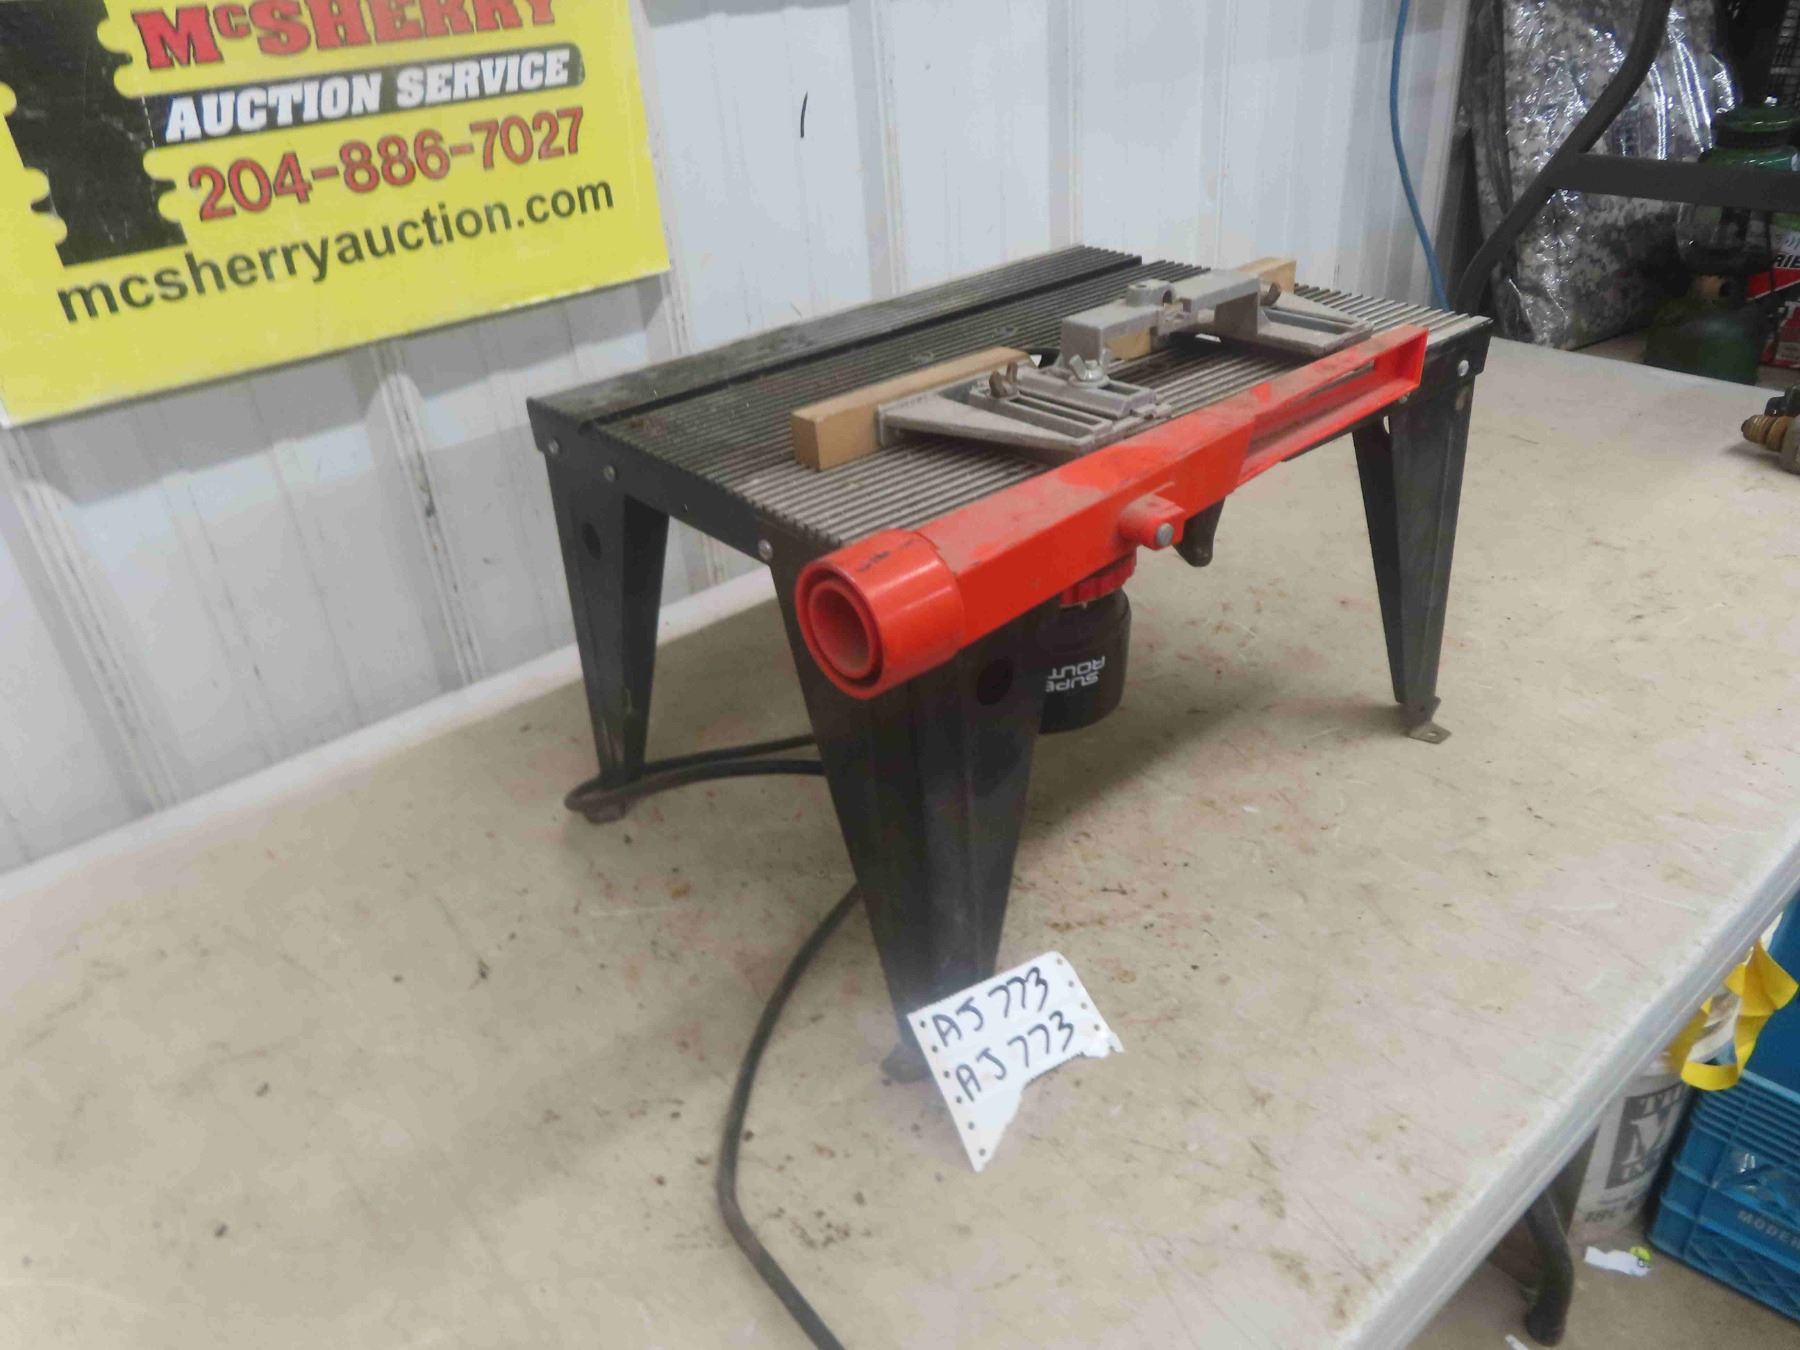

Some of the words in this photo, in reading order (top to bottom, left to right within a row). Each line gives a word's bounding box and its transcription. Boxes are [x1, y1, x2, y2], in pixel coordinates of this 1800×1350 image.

[165, 72, 382, 143] AUCTION
[396, 47, 571, 107] SERVICE
[187, 106, 586, 223] 204-886-7027
[57, 180, 614, 323] mcsherryauction.com
[931, 996, 985, 1047] AJ
[987, 966, 1048, 1018] 773
[955, 1048, 1007, 1102] AJ
[1006, 1010, 1074, 1068] 773
